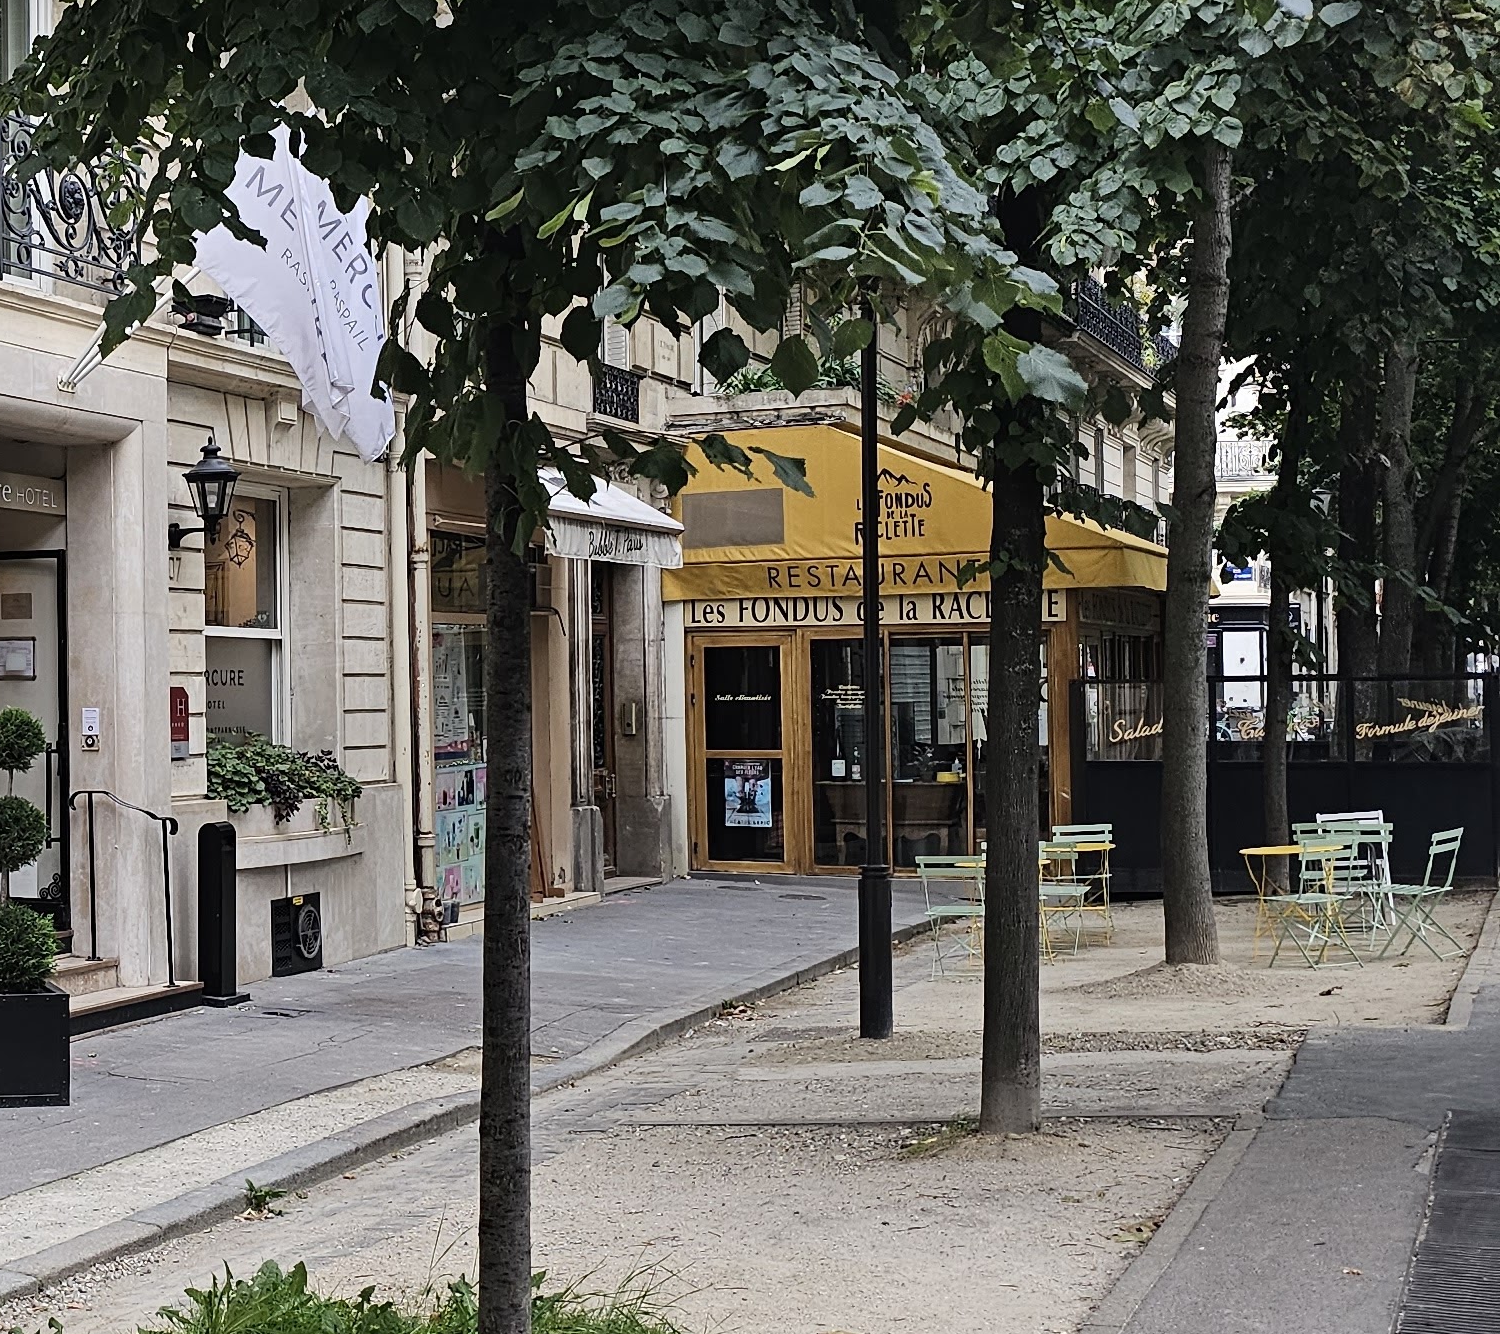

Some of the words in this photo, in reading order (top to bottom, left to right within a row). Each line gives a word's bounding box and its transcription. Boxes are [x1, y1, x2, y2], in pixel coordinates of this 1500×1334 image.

[16, 487, 58, 508] HOTEL
[877, 482, 932, 518] FONDUS
[886, 510, 895, 519] DE
[899, 509, 909, 519] LA
[854, 513, 925, 546] RCLETTE
[689, 598, 726, 624] Les
[738, 596, 844, 623] FONDUS
[899, 594, 918, 621] la
[176, 698, 186, 717] H
[1355, 713, 1417, 739] Formule
